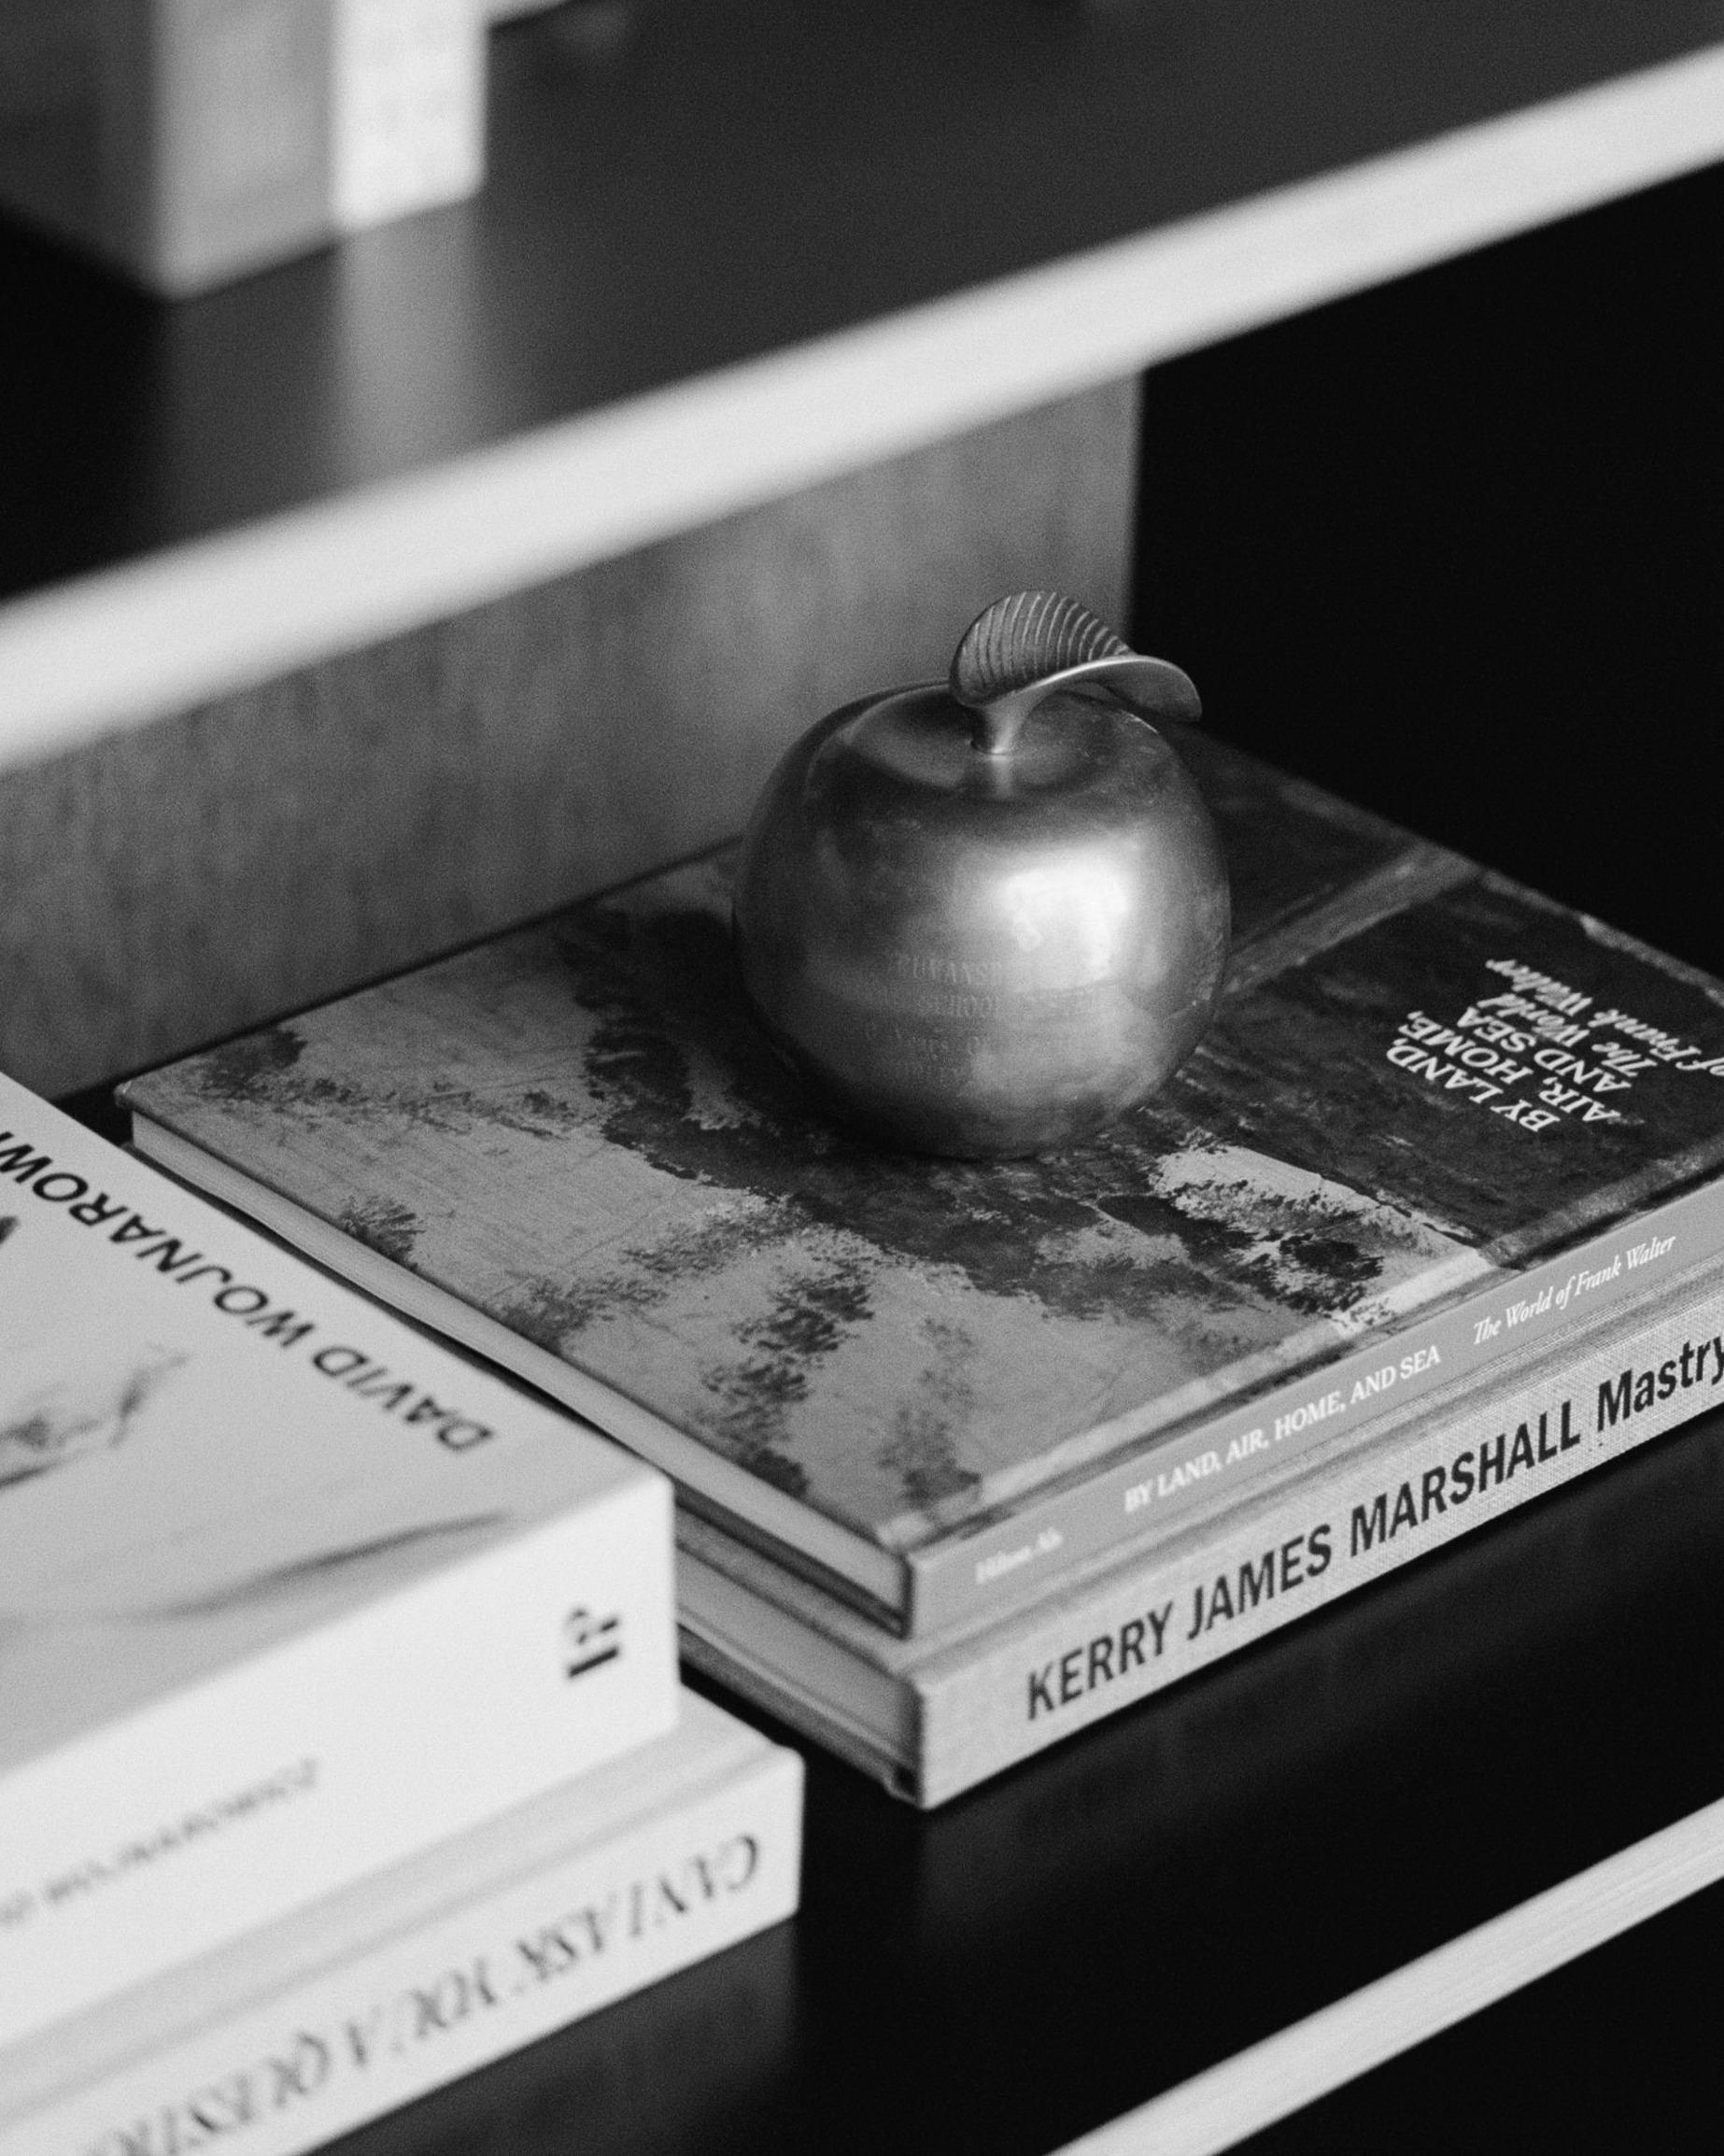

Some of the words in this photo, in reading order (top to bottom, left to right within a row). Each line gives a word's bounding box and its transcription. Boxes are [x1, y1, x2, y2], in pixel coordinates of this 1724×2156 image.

[1485, 959, 1593, 1016] Walter
[1399, 1010, 1533, 1085] HOME,
[1457, 1006, 1537, 1053] SEA
[1477, 993, 1590, 1048] World
[1588, 1009, 1702, 1061] Frank
[1386, 1038, 1504, 1104] LAND,
[1533, 1048, 1632, 1093] AND
[1591, 1042, 1658, 1077] The
[1491, 1099, 1561, 1132] BY
[1539, 1076, 1621, 1122] AIR,
[0, 1130, 314, 1349] WOJNAROW
[1473, 1316, 1502, 1345] The
[1505, 1286, 1554, 1328] World
[1555, 1275, 1576, 1311] of
[1574, 1255, 1622, 1298] Frank
[1625, 1235, 1676, 1270] Walter
[311, 1343, 496, 1454] DAVID
[1124, 1478, 1154, 1513] BY
[1157, 1451, 1223, 1497] LAND,
[1225, 1428, 1271, 1465] AIR,
[1274, 1390, 1348, 1441] HOME,
[1350, 1366, 1397, 1404] AND
[1400, 1344, 1441, 1380] SEA
[1025, 1600, 1174, 1722] KERRY
[1186, 1523, 1333, 1641] JAMES
[1349, 1399, 1581, 1559] MARSHALL
